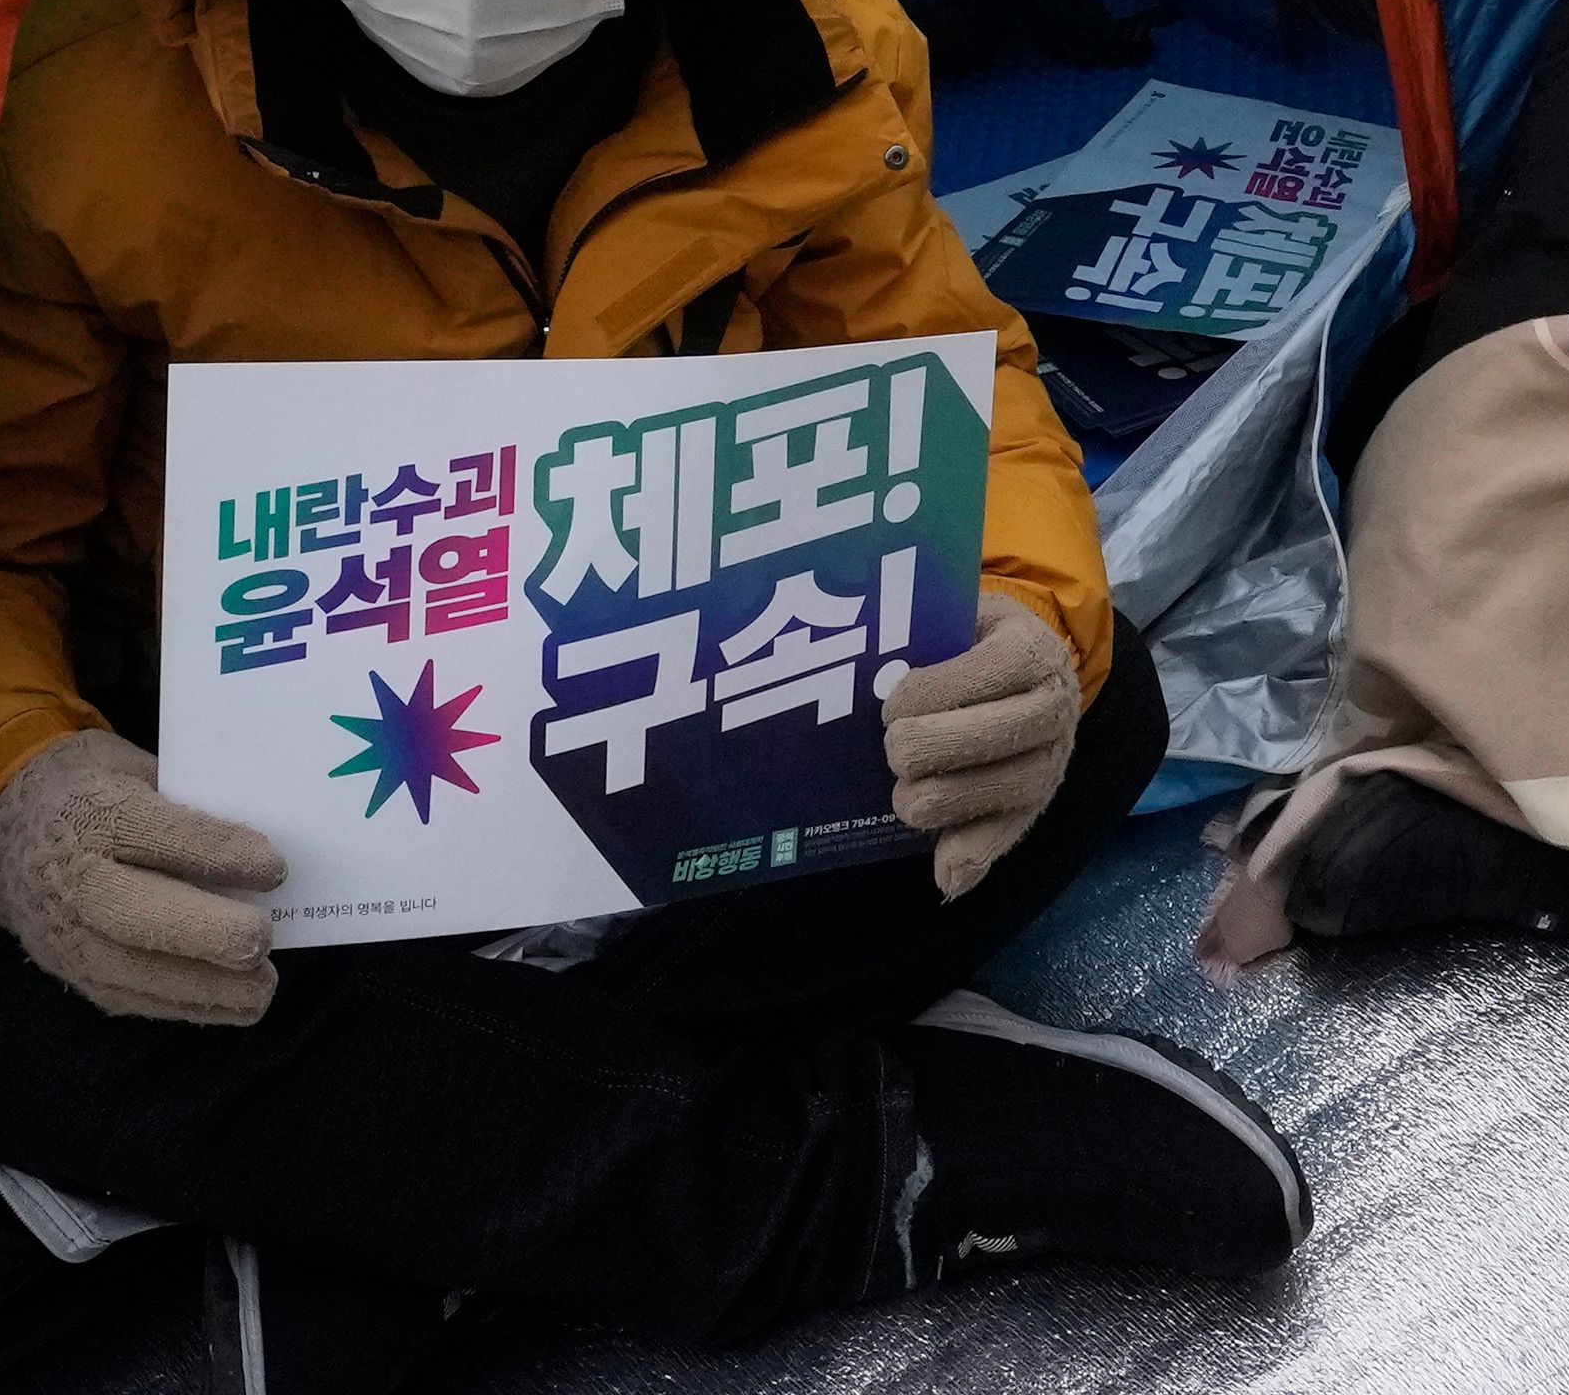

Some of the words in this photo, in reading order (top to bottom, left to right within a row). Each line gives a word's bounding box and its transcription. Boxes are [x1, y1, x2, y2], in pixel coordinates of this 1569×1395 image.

[1245, 118, 1325, 206] 윤석열
[1301, 128, 1371, 211] 내란수괴
[1064, 187, 1218, 315] 구속!
[1178, 204, 1336, 322] 체포!
[215, 443, 517, 564] 내란수괴
[539, 366, 928, 601] 체포!
[213, 527, 512, 676] 윤석열
[543, 546, 918, 796] 구속!
[672, 844, 764, 883] 비상행동
[804, 820, 850, 838] 카카오뱅크
[851, 813, 897, 829] 7942-09
[302, 902, 353, 920] 희생자의
[357, 900, 396, 917] 명복을
[399, 895, 437, 912] 빕니다
